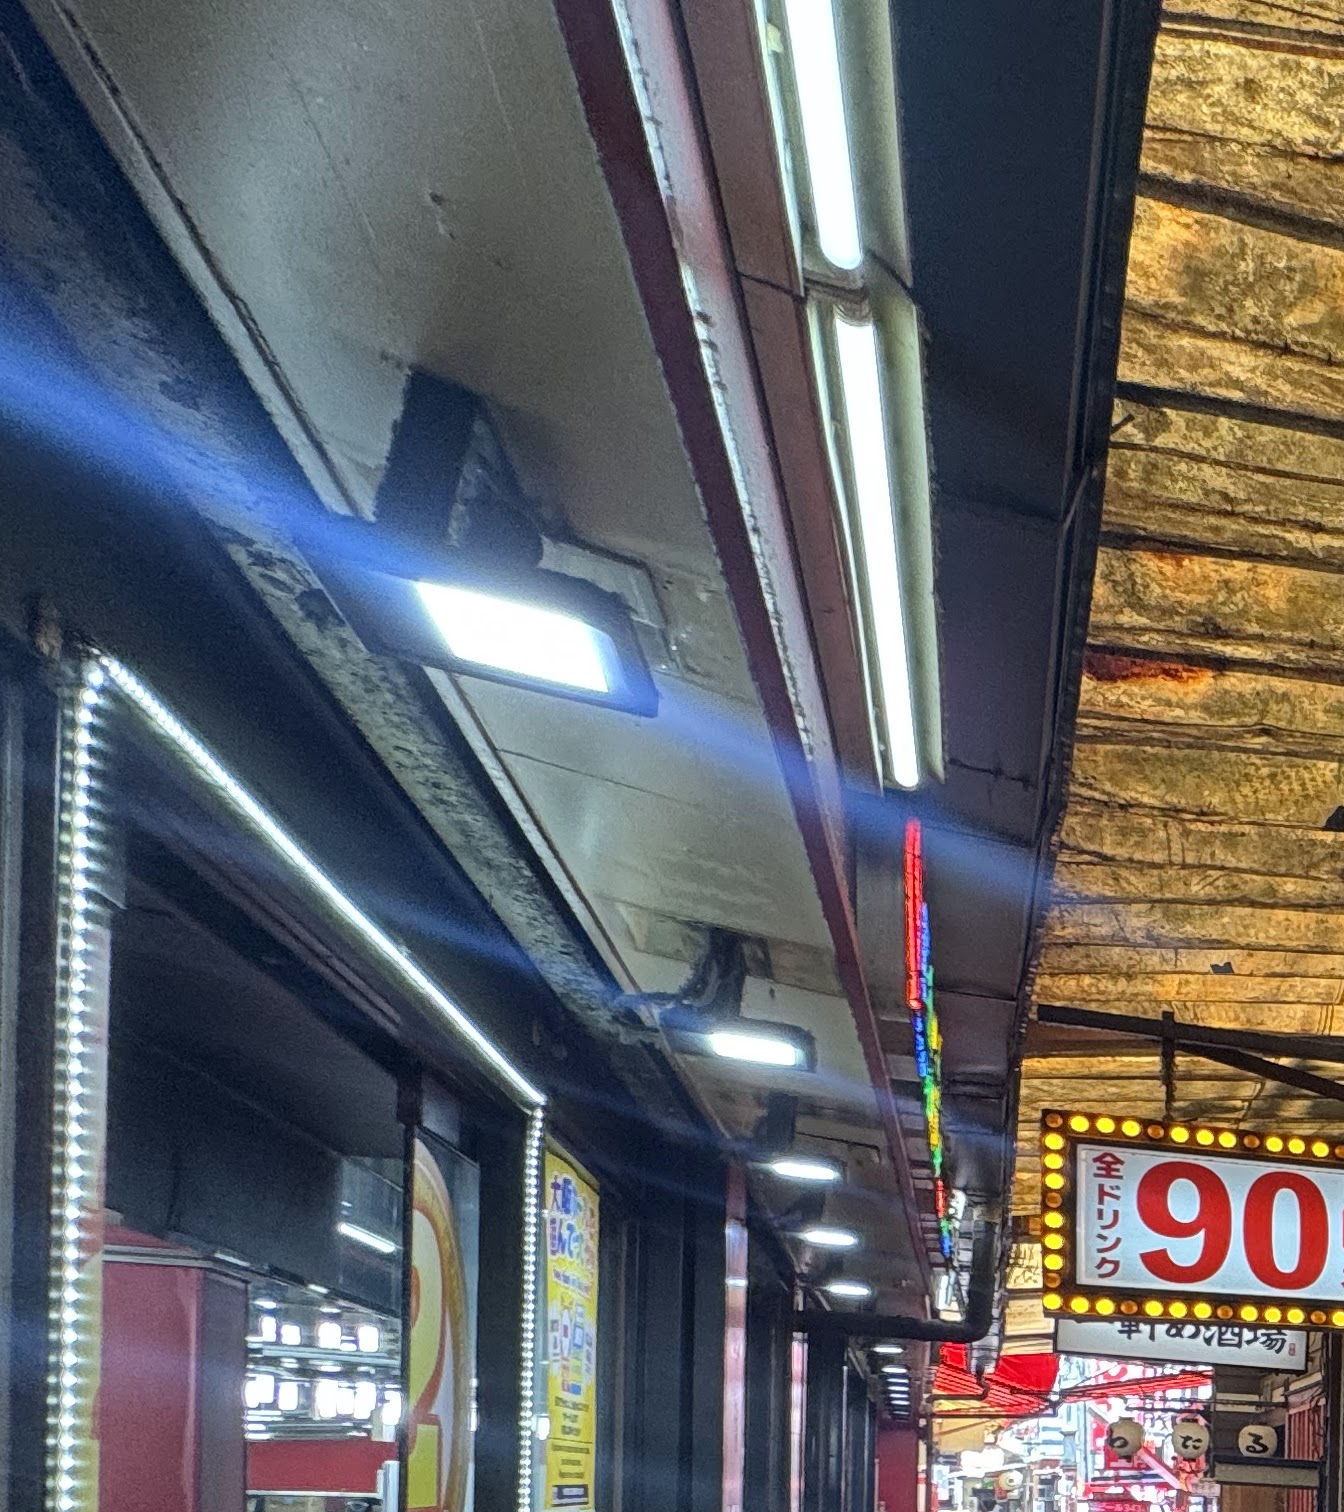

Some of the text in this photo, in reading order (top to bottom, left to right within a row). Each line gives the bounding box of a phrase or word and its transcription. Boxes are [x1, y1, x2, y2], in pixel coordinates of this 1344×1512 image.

[1092, 1151, 1125, 1279] 全ドリンク
[1137, 1161, 1329, 1290] 90
